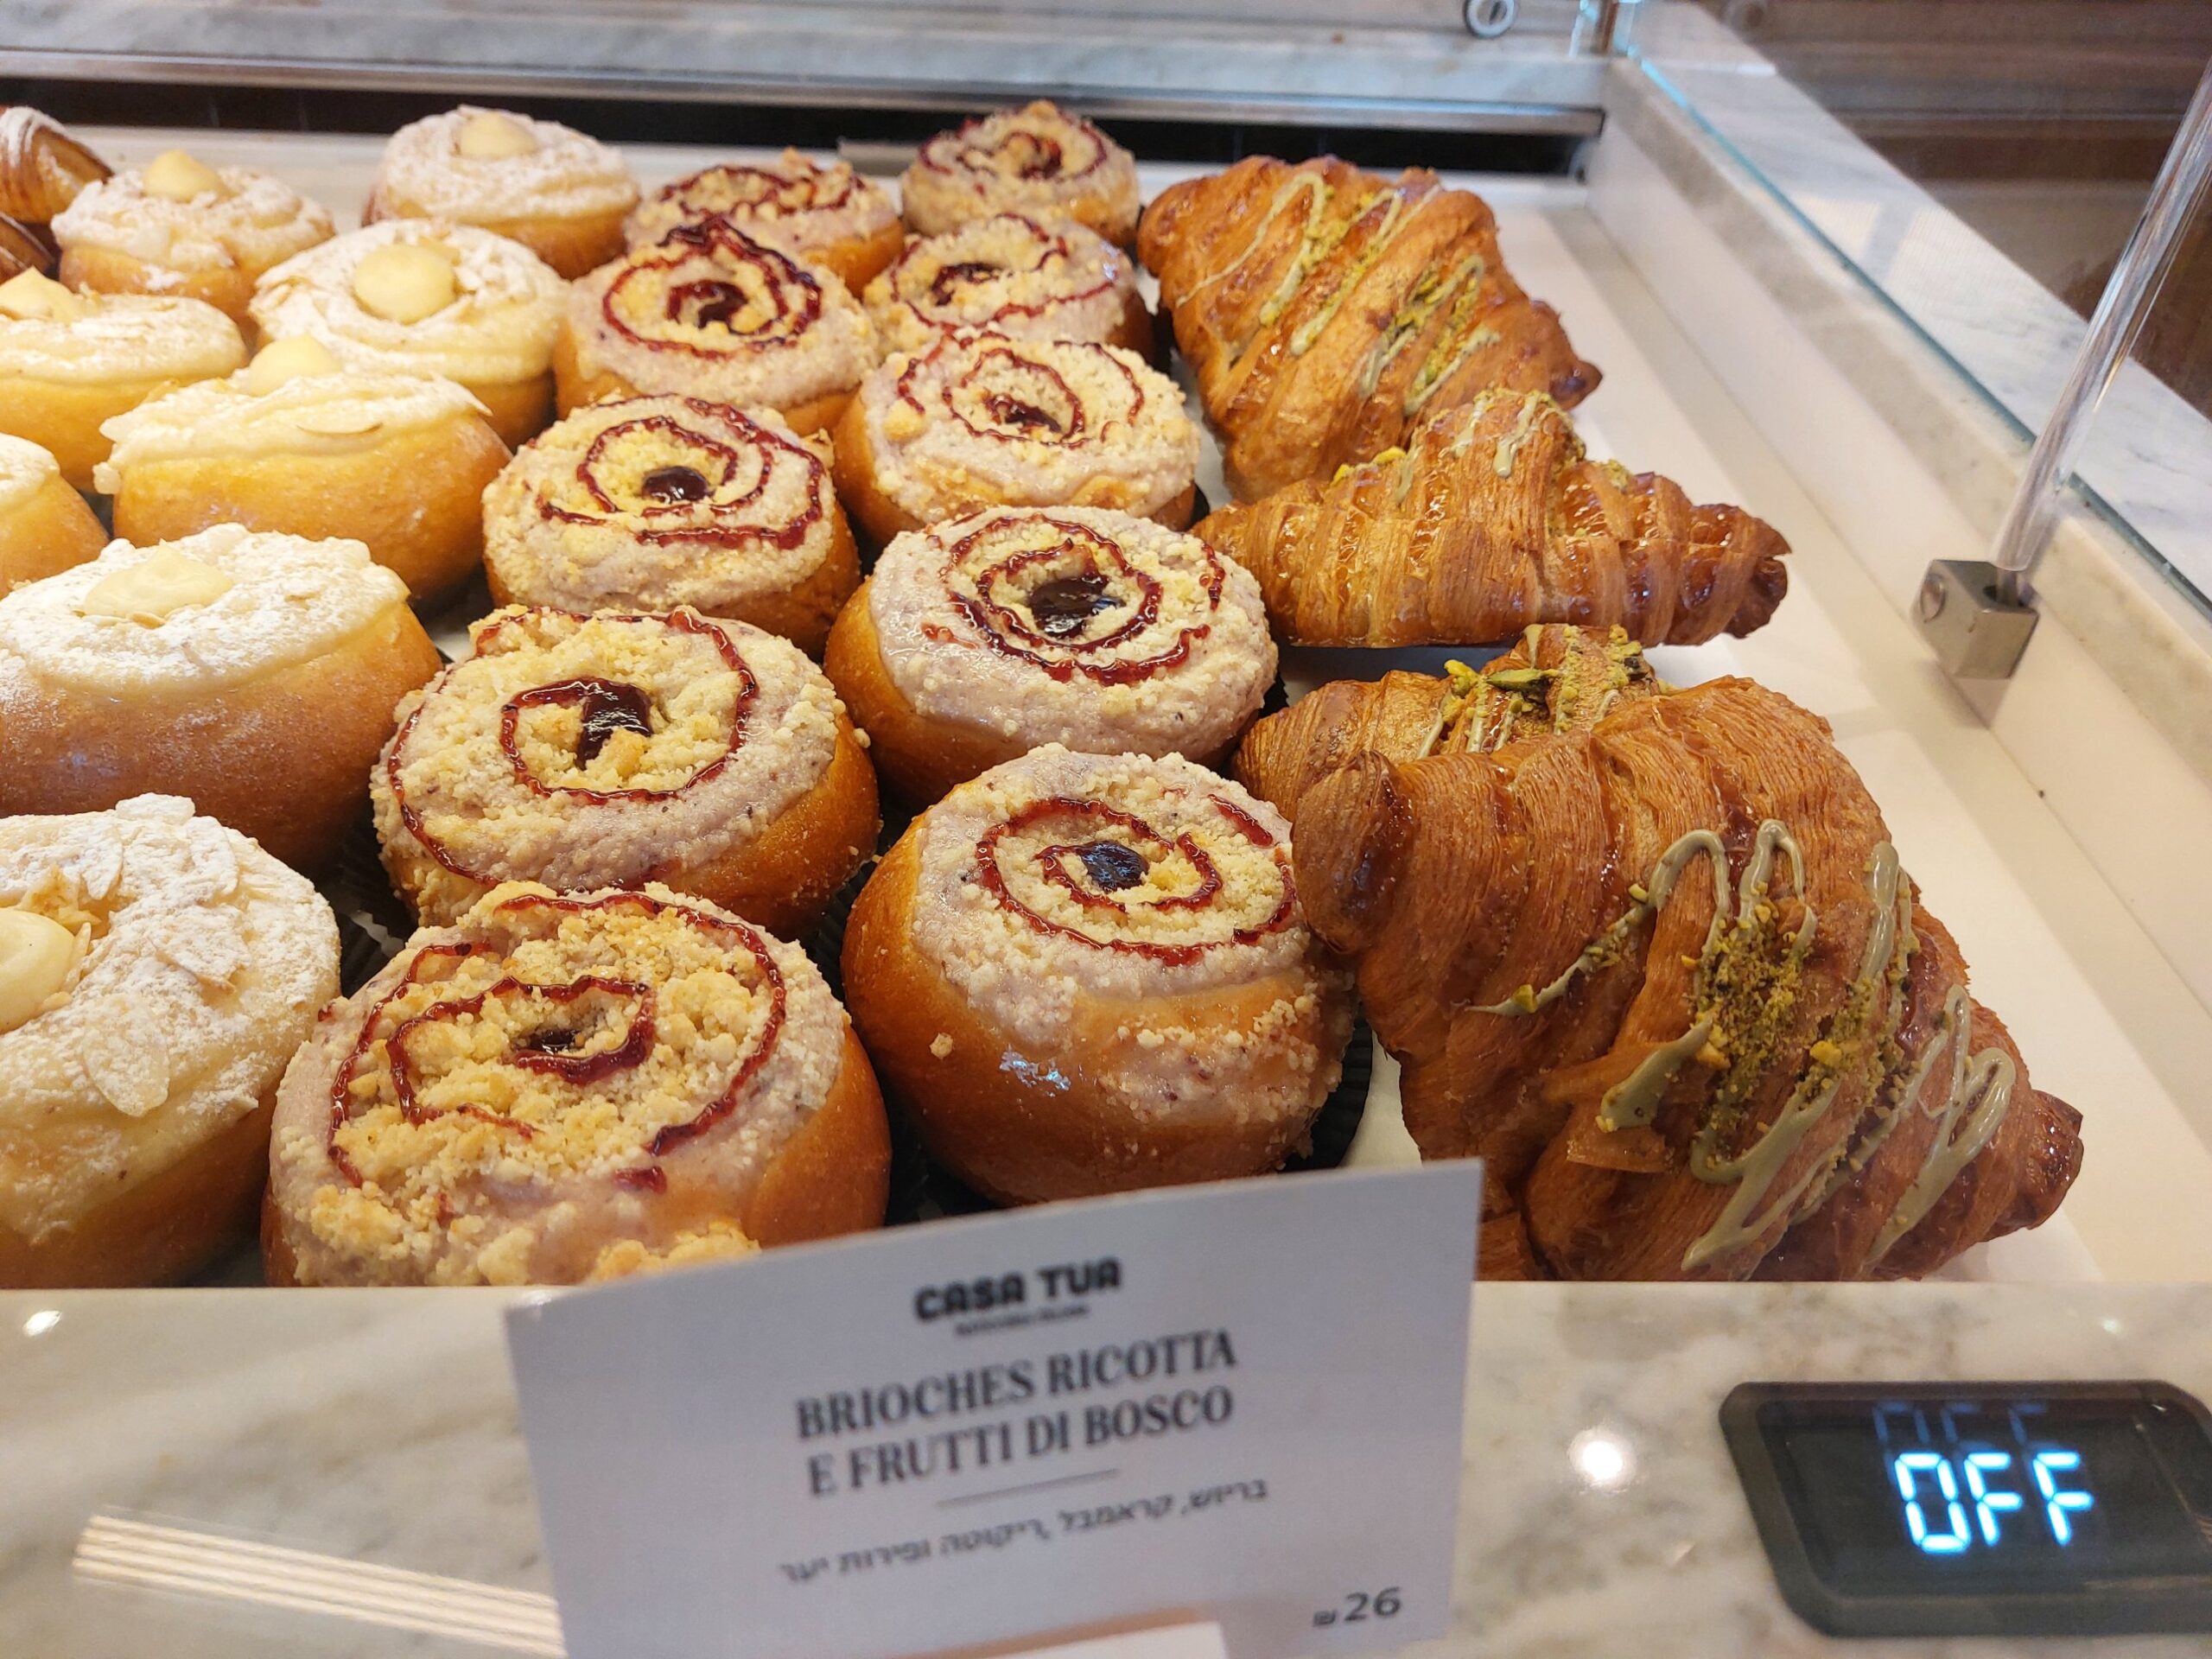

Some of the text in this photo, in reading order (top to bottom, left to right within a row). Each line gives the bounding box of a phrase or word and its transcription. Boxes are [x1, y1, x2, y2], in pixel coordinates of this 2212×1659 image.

[914, 1271, 1026, 1323] CASA
[1035, 1256, 1122, 1300] TUA
[797, 1328, 1236, 1438] BRIOCHES RICOTTA
[809, 1384, 1234, 1494] E FRUTTI DI BOSCO
[1894, 1452, 2094, 1554] OFF
